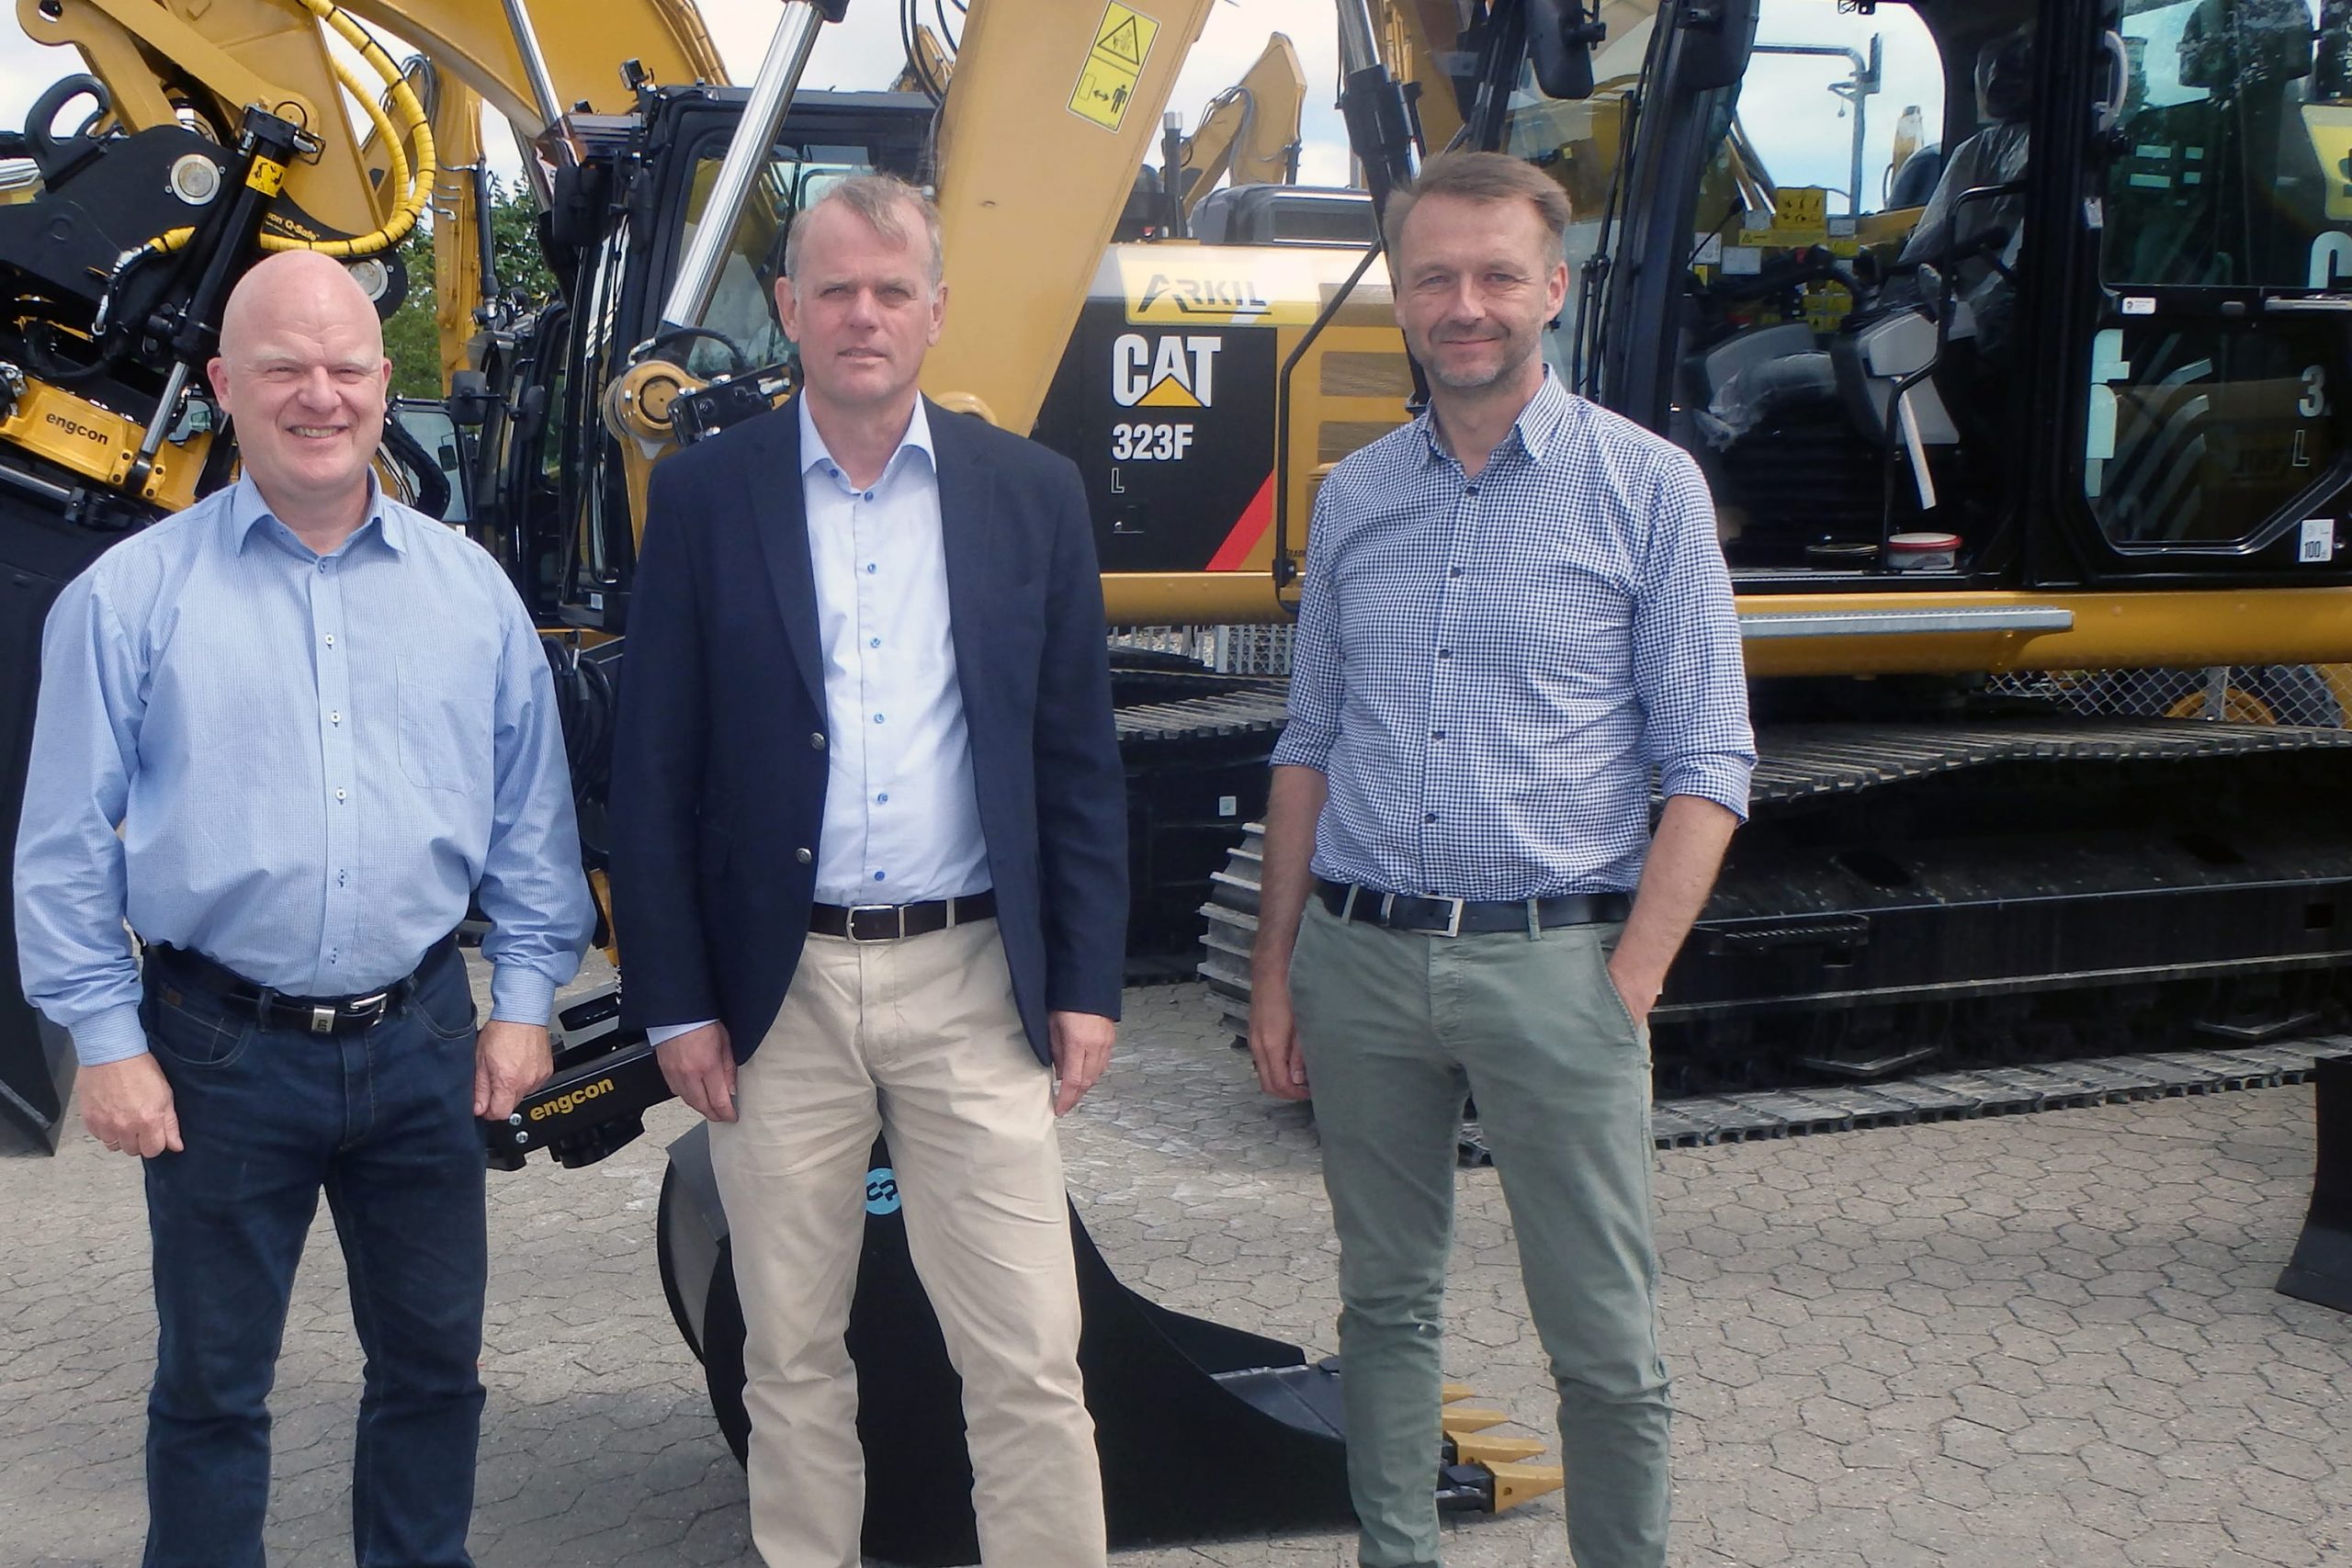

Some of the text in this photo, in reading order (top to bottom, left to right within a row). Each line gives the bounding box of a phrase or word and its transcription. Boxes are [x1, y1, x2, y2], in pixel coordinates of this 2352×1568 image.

[1137, 274, 1272, 313] ARKIL
[1113, 333, 1221, 407] CAT
[46, 412, 108, 446] engcon
[1112, 423, 1193, 460] 323F
[1111, 467, 1125, 493] L
[529, 1077, 615, 1121] engcon
